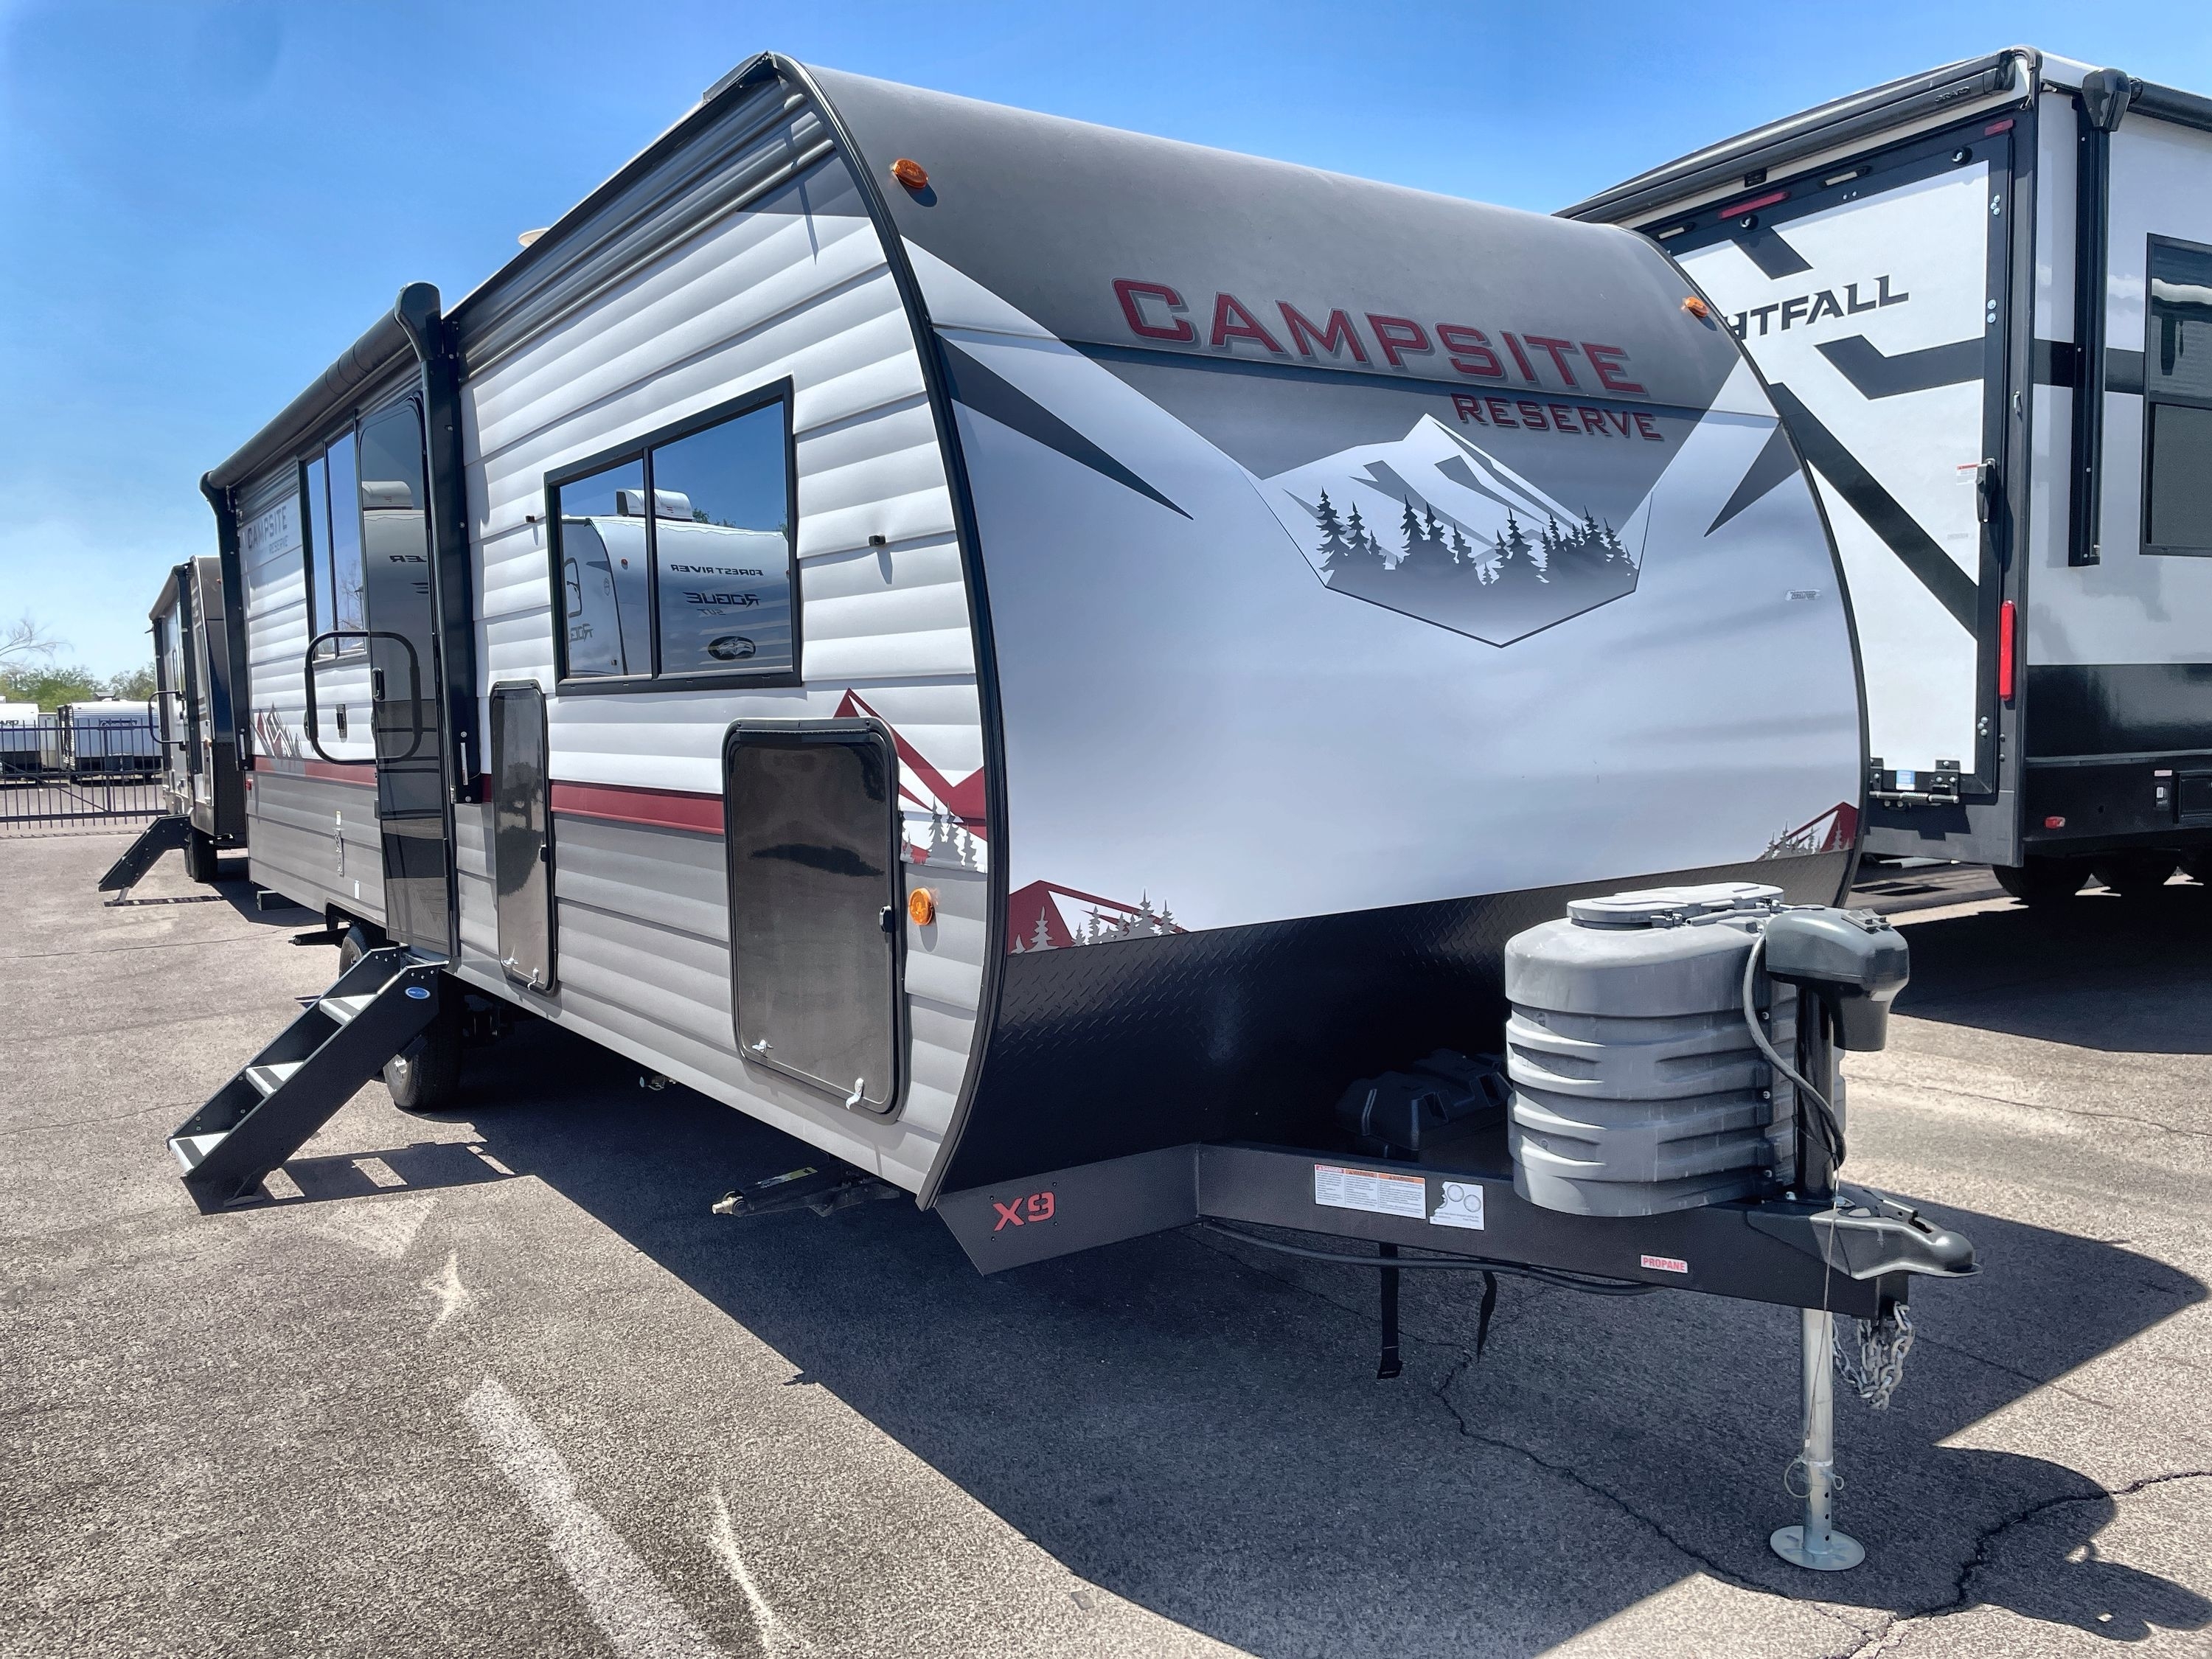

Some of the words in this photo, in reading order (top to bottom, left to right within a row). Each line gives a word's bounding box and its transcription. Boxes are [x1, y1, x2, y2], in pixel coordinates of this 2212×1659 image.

[1111, 277, 1649, 395] CAMPSITE
[1450, 392, 1664, 441] RESERVE
[248, 506, 288, 550] CAMPSITE
[992, 1191, 1056, 1232] X9
[1643, 1257, 1686, 1271] PROPANE
